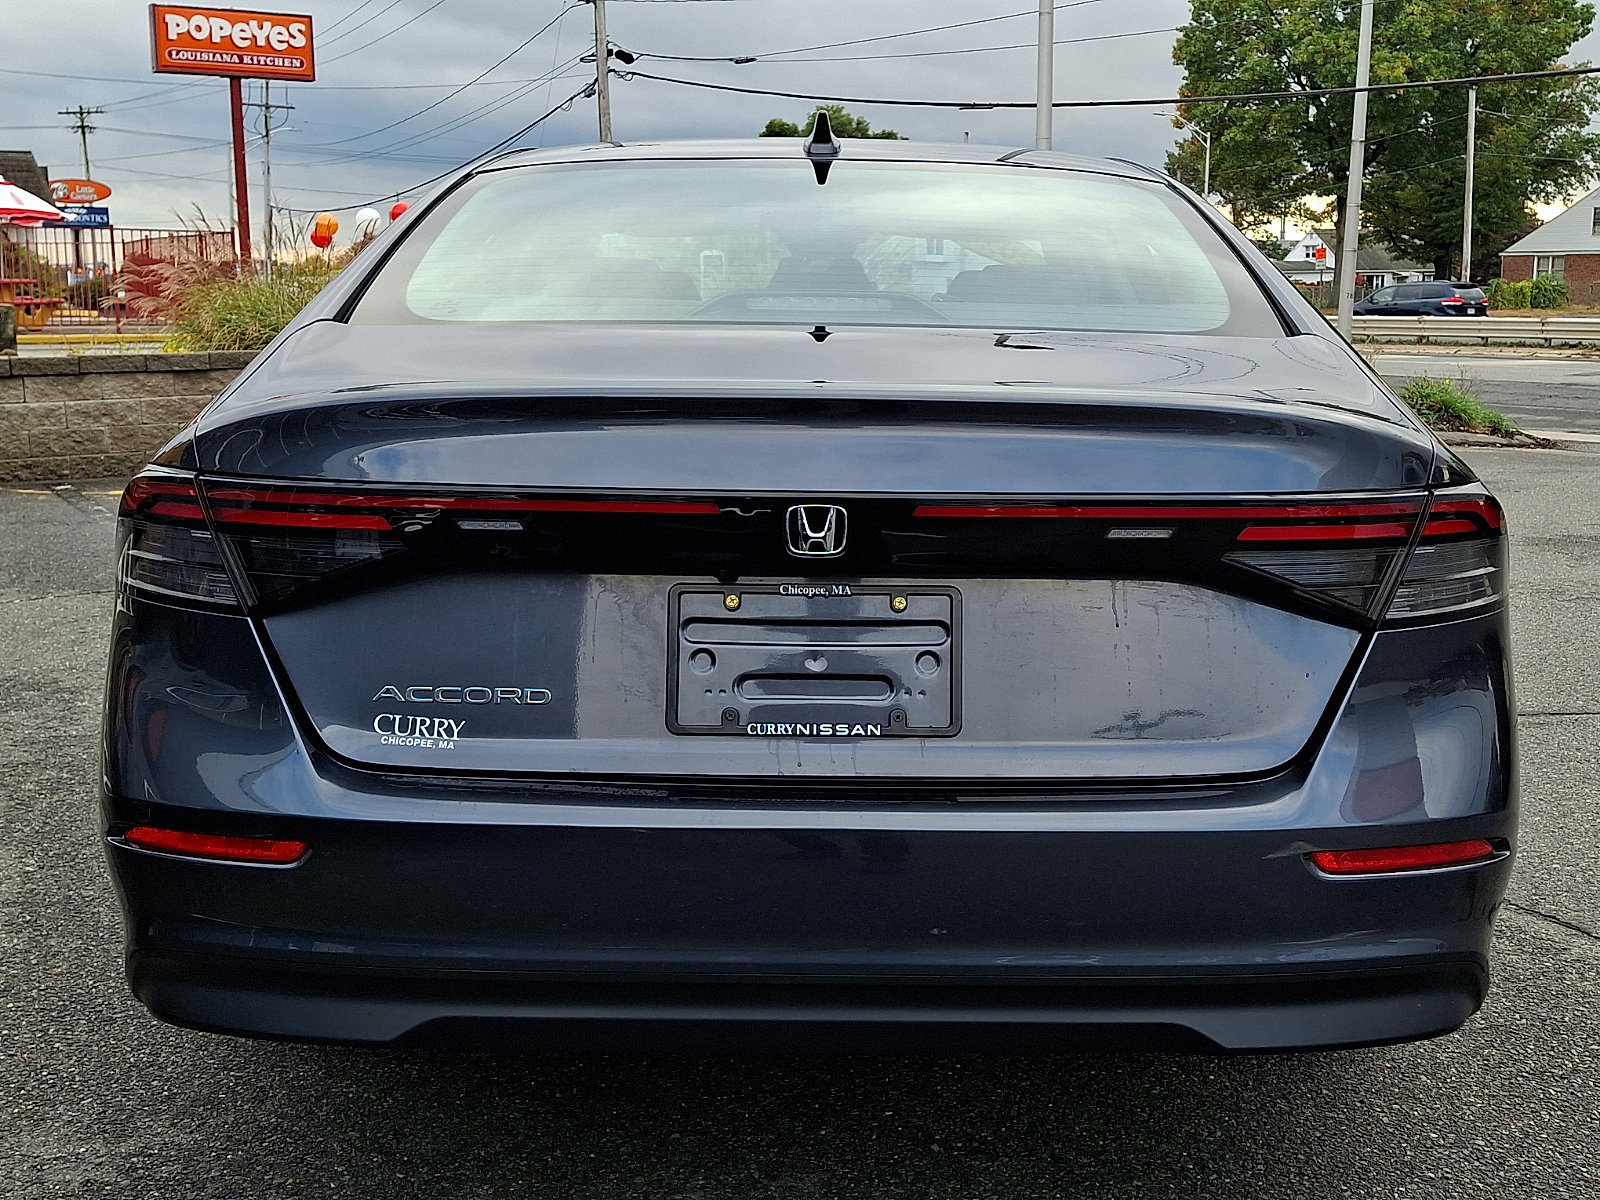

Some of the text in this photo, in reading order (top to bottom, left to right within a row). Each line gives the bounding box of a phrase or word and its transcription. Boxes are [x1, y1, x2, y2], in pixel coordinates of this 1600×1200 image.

[171, 50, 301, 67] LOUISIANA KITCHEN
[780, 584, 852, 597] Chicopee, MA
[372, 685, 552, 705] ACCORD
[373, 713, 466, 741] CURRY
[381, 736, 455, 750] CHICOPEE, MA
